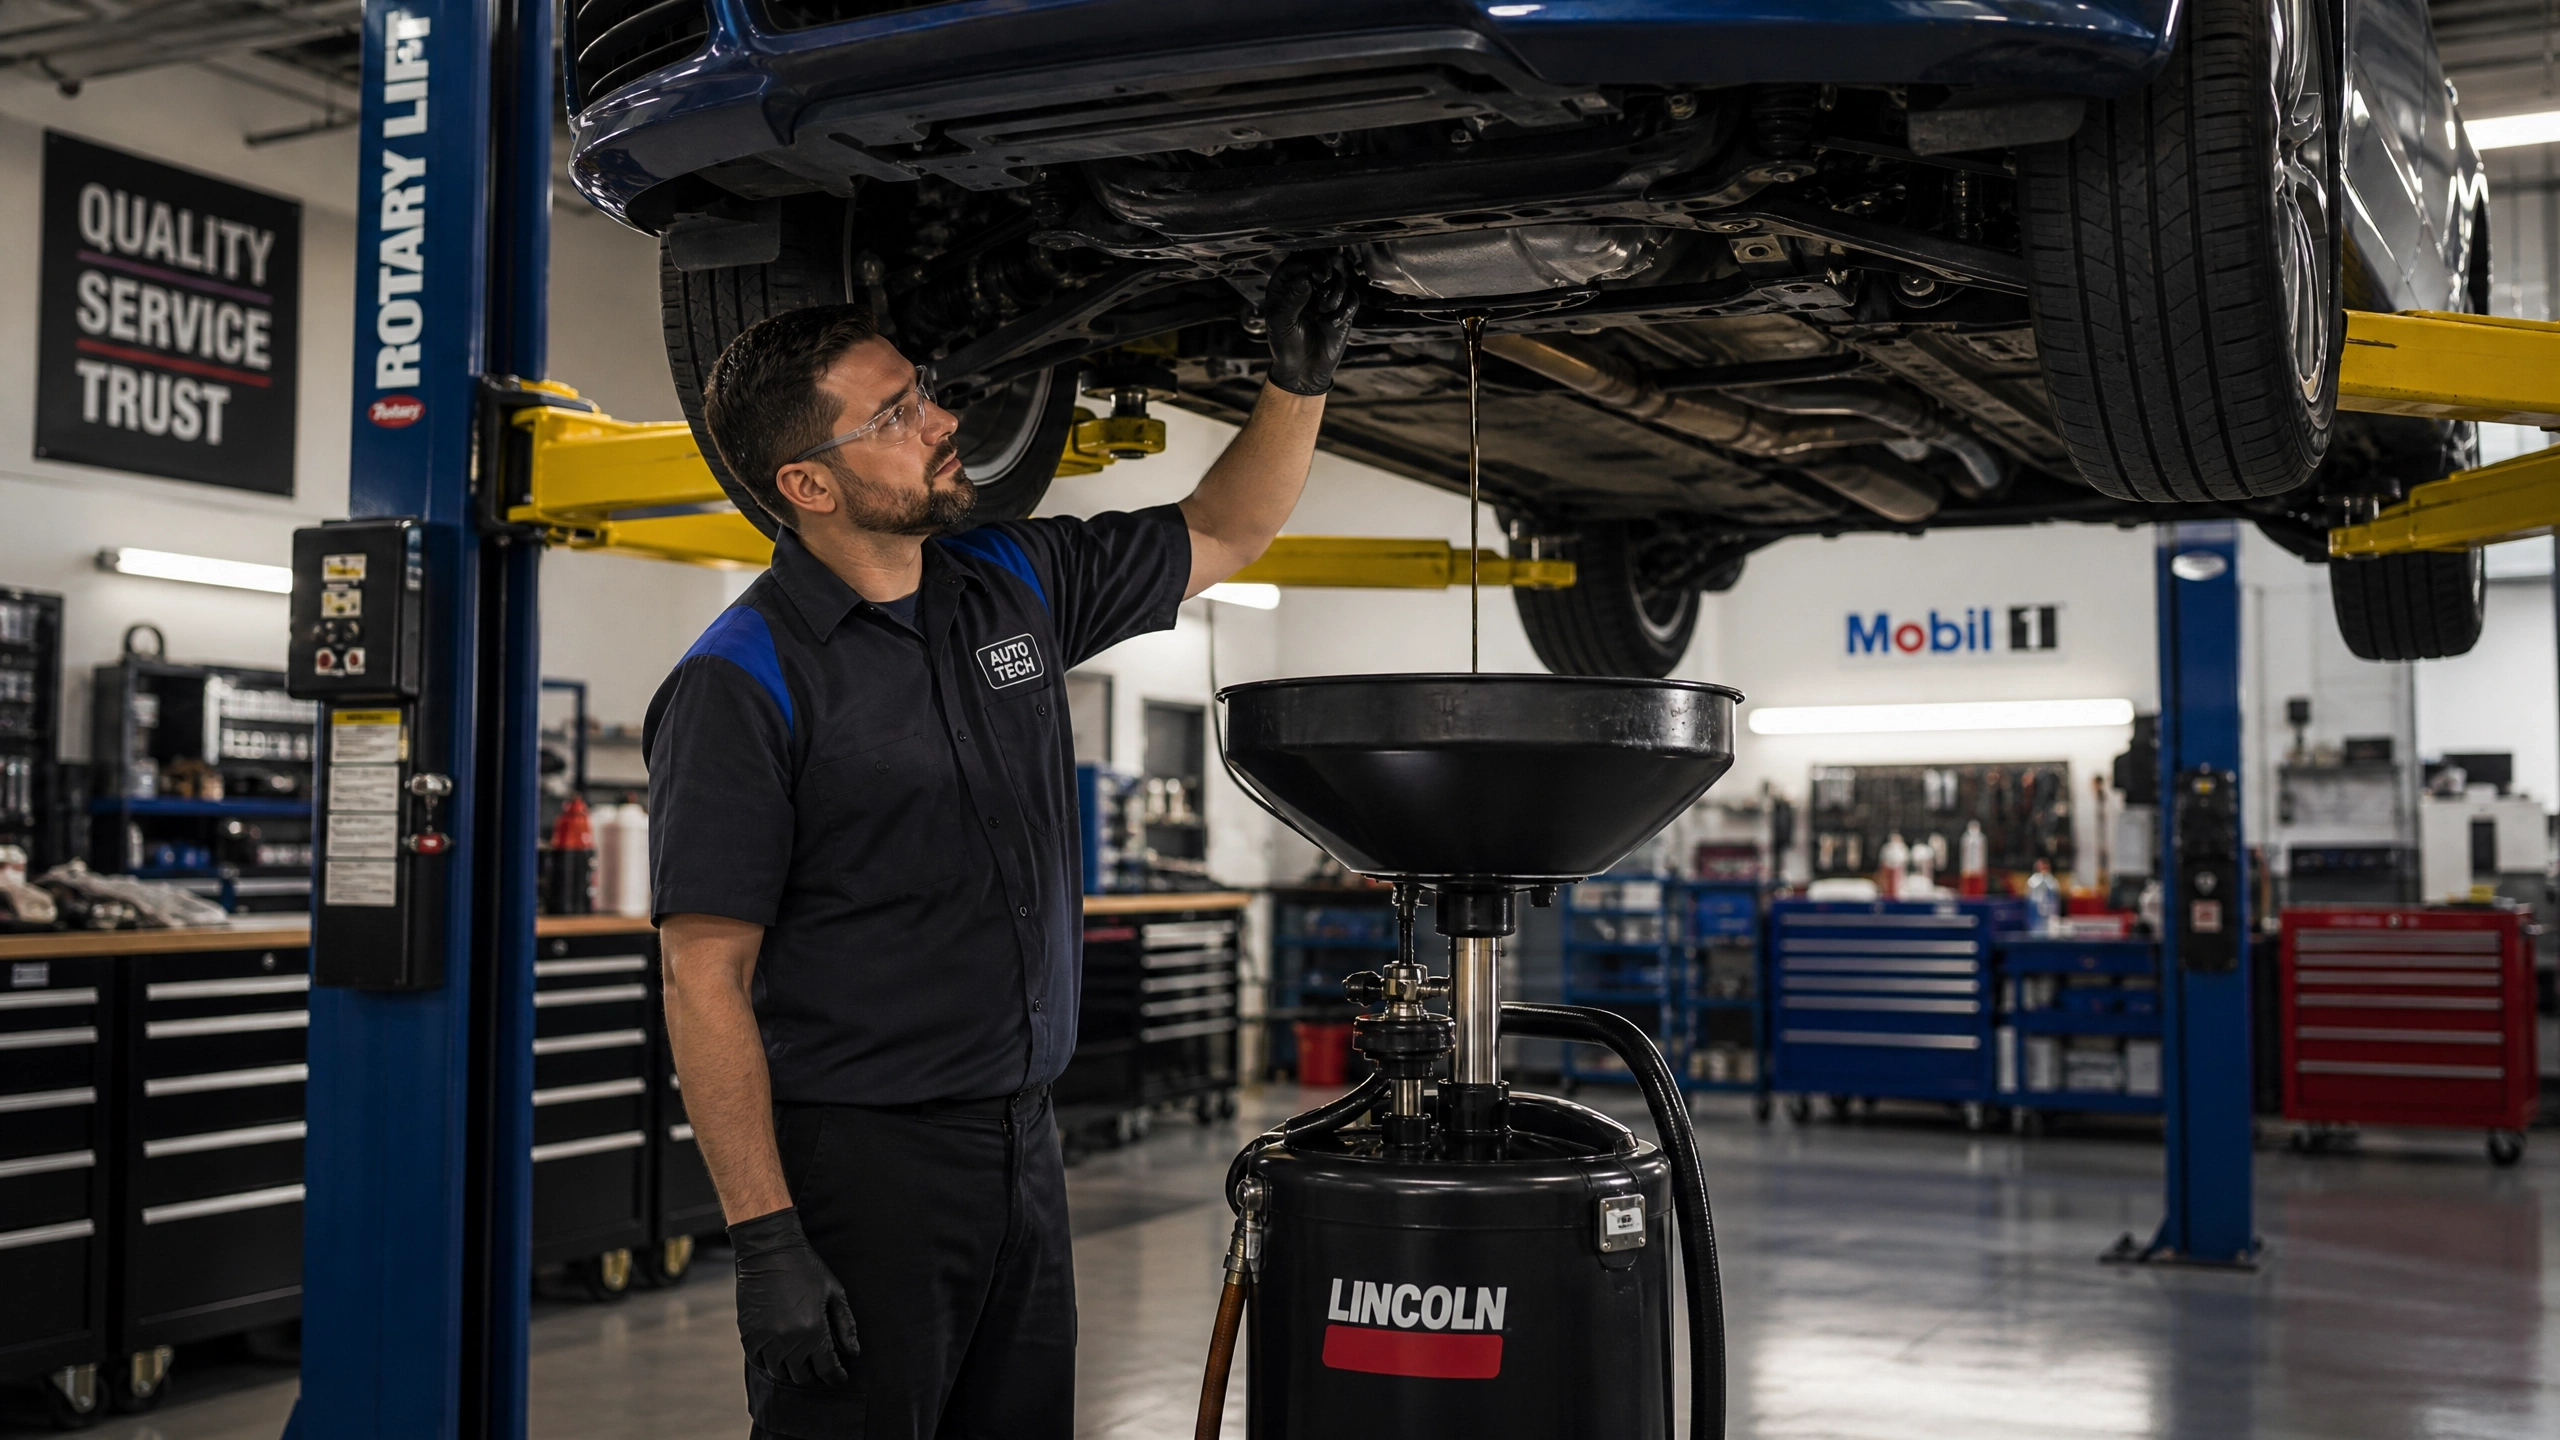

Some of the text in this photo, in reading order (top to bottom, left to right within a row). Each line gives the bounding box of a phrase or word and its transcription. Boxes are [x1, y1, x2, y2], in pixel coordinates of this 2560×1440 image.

[78, 182, 275, 286] QUALITY
[376, 11, 430, 389] ROTARY LIFT
[76, 269, 272, 370] SERVICE
[75, 358, 231, 446] TRUST
[990, 641, 1029, 667] AUTO
[1847, 608, 1992, 654] Mobil
[994, 656, 1036, 681] TECH
[1328, 1278, 1507, 1330] LINCOLN
